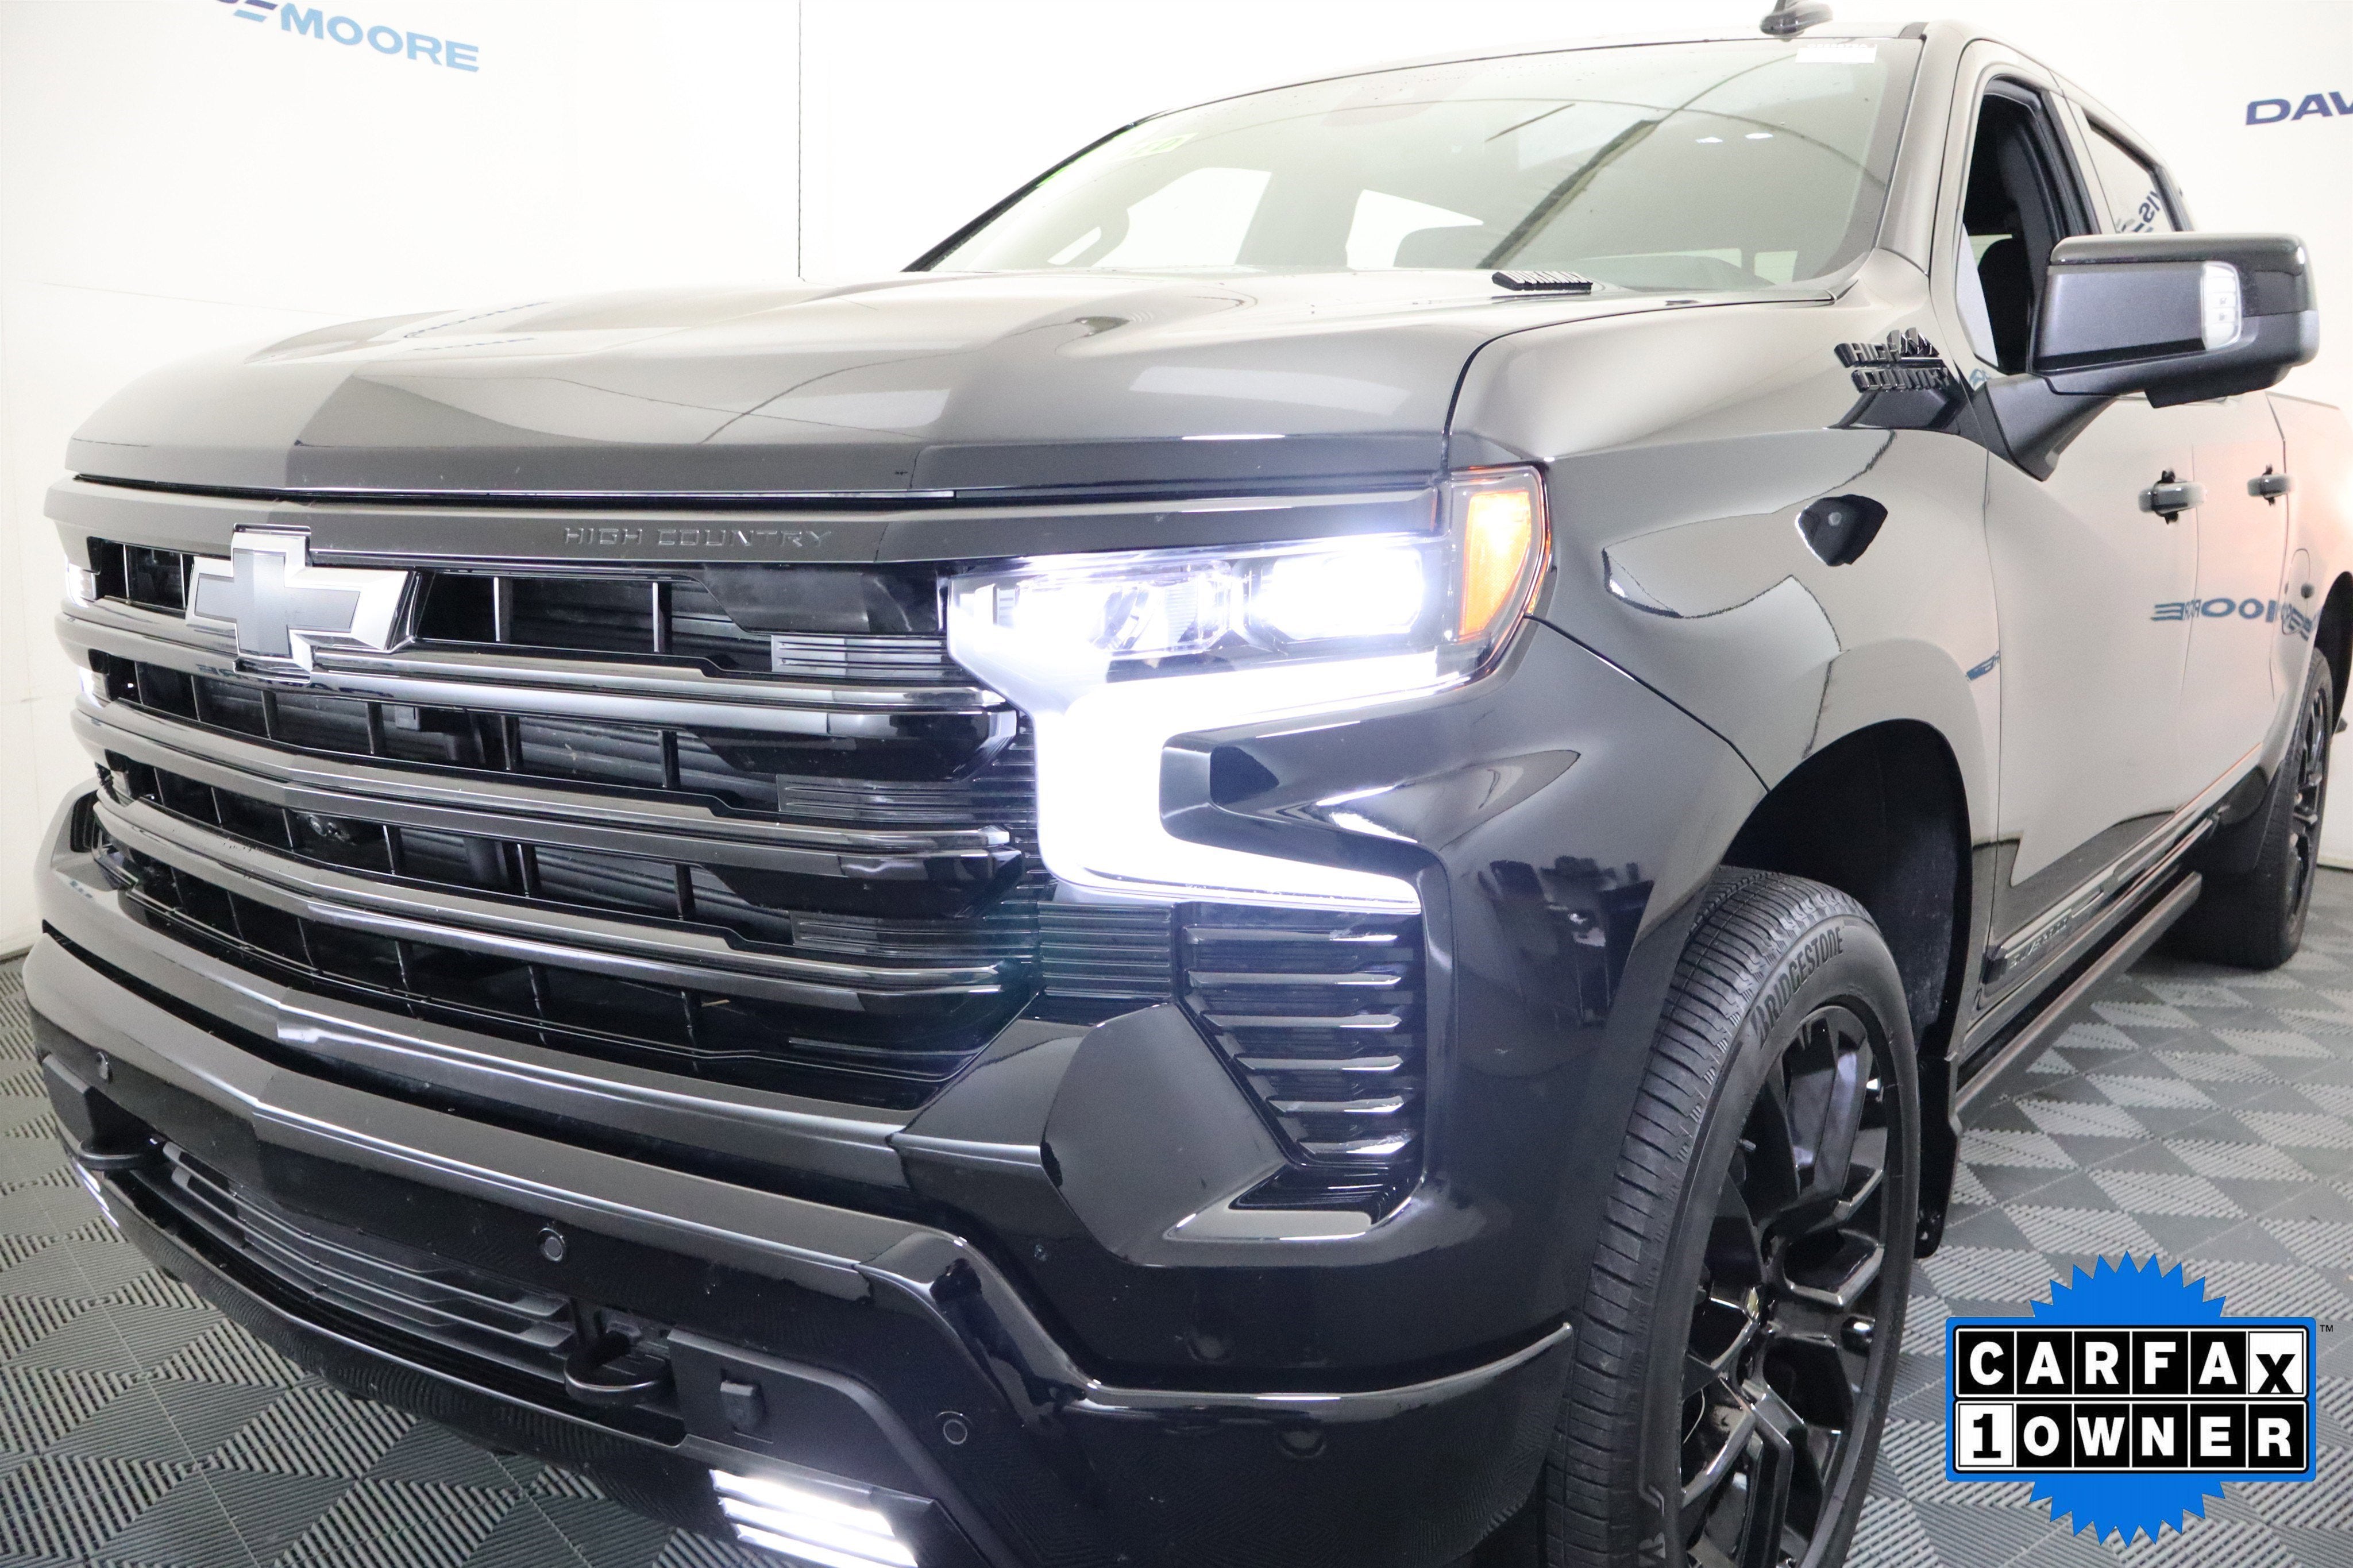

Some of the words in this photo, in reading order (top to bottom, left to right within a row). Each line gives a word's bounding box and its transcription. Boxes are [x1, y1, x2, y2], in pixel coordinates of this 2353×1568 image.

[280, 2, 480, 73] MOORE
[1838, 343, 1901, 365] HIGH
[564, 527, 643, 545] HIGH
[657, 528, 832, 547] COUNTRY
[1750, 926, 1843, 1051] BRIDGESTONE
